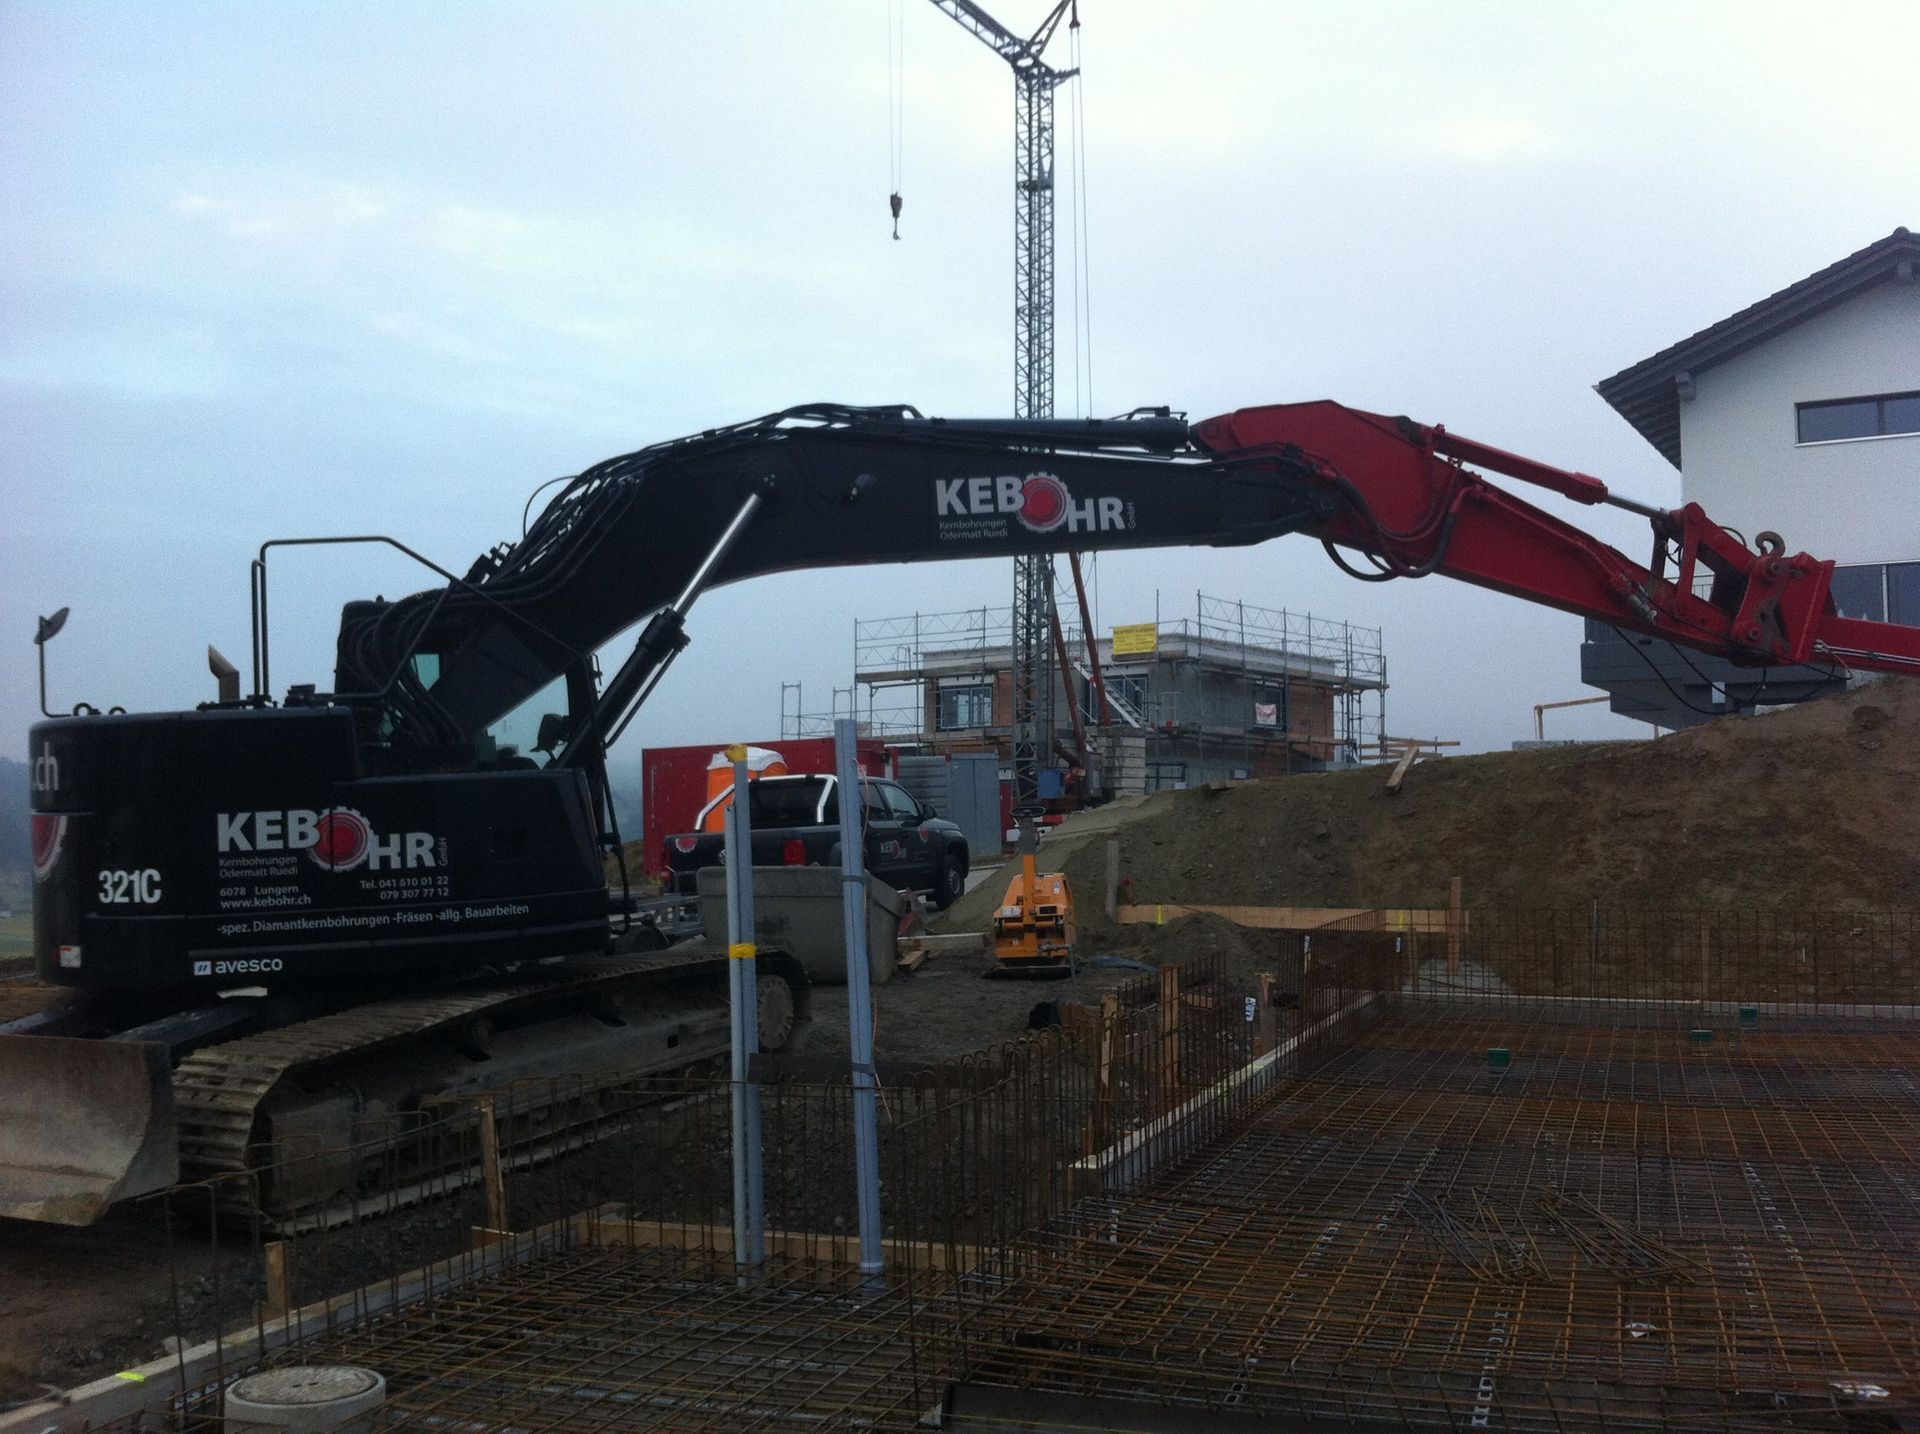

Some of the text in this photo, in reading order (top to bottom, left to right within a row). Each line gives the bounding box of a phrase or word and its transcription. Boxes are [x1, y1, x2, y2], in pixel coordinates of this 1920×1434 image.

[939, 520, 1007, 530] Kernbohrungen
[940, 529, 1008, 539] Odermatt Ruedi
[438, 837, 448, 867] GmbH
[219, 856, 298, 867] Kernbohrungen
[220, 866, 298, 878] Odermatt Ruedi
[98, 869, 162, 904] 321C
[360, 880, 376, 889] Tel.
[379, 879, 397, 888] 041
[421, 876, 433, 886] 01
[436, 875, 449, 885] 22
[219, 885, 299, 897] 6078 Lungern
[380, 887, 449, 900] 079 307 77 12
[220, 895, 312, 908] www.kebohr.ch
[217, 923, 251, 935] -spez.
[253, 914, 390, 931] Diamantkernbohrungen
[392, 911, 433, 924] -Fräsen
[465, 904, 530, 919] Bauarbeiten
[215, 958, 283, 974] avesco
